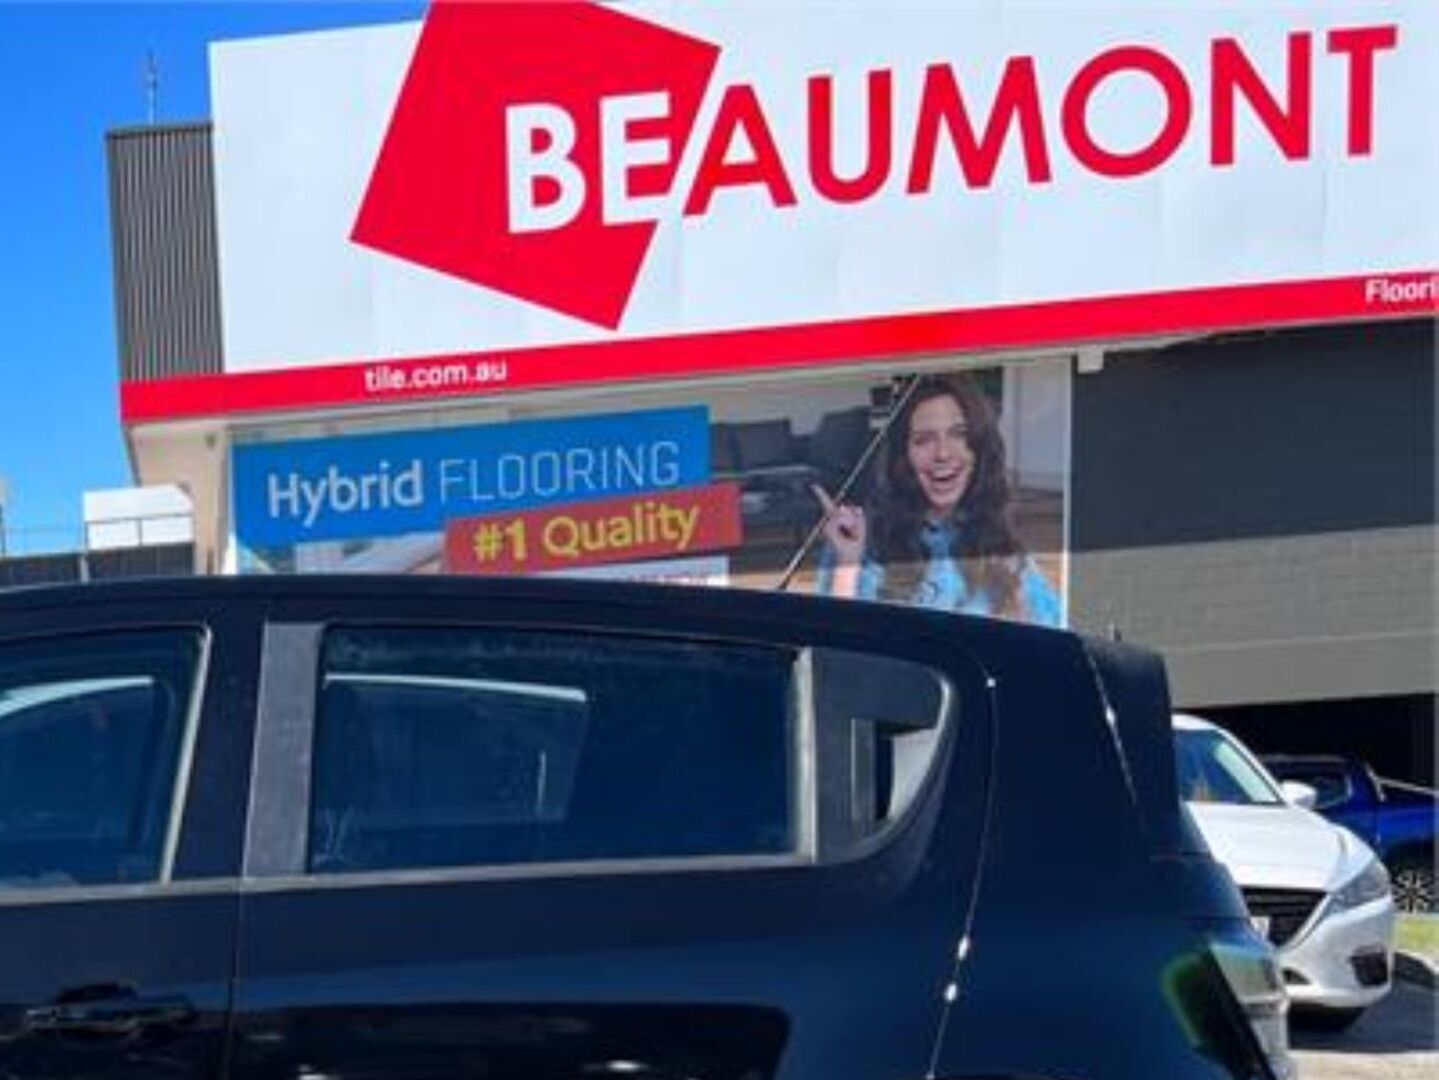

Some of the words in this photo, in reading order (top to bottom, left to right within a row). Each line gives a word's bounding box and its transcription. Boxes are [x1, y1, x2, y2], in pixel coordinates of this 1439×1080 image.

[505, 25, 1398, 233] BEAUMONT
[365, 359, 507, 391] tile.com.au
[267, 459, 424, 527] Hybrid
[439, 440, 681, 505] FLOORING
[472, 517, 527, 562] #1
[543, 502, 699, 557] Quality
